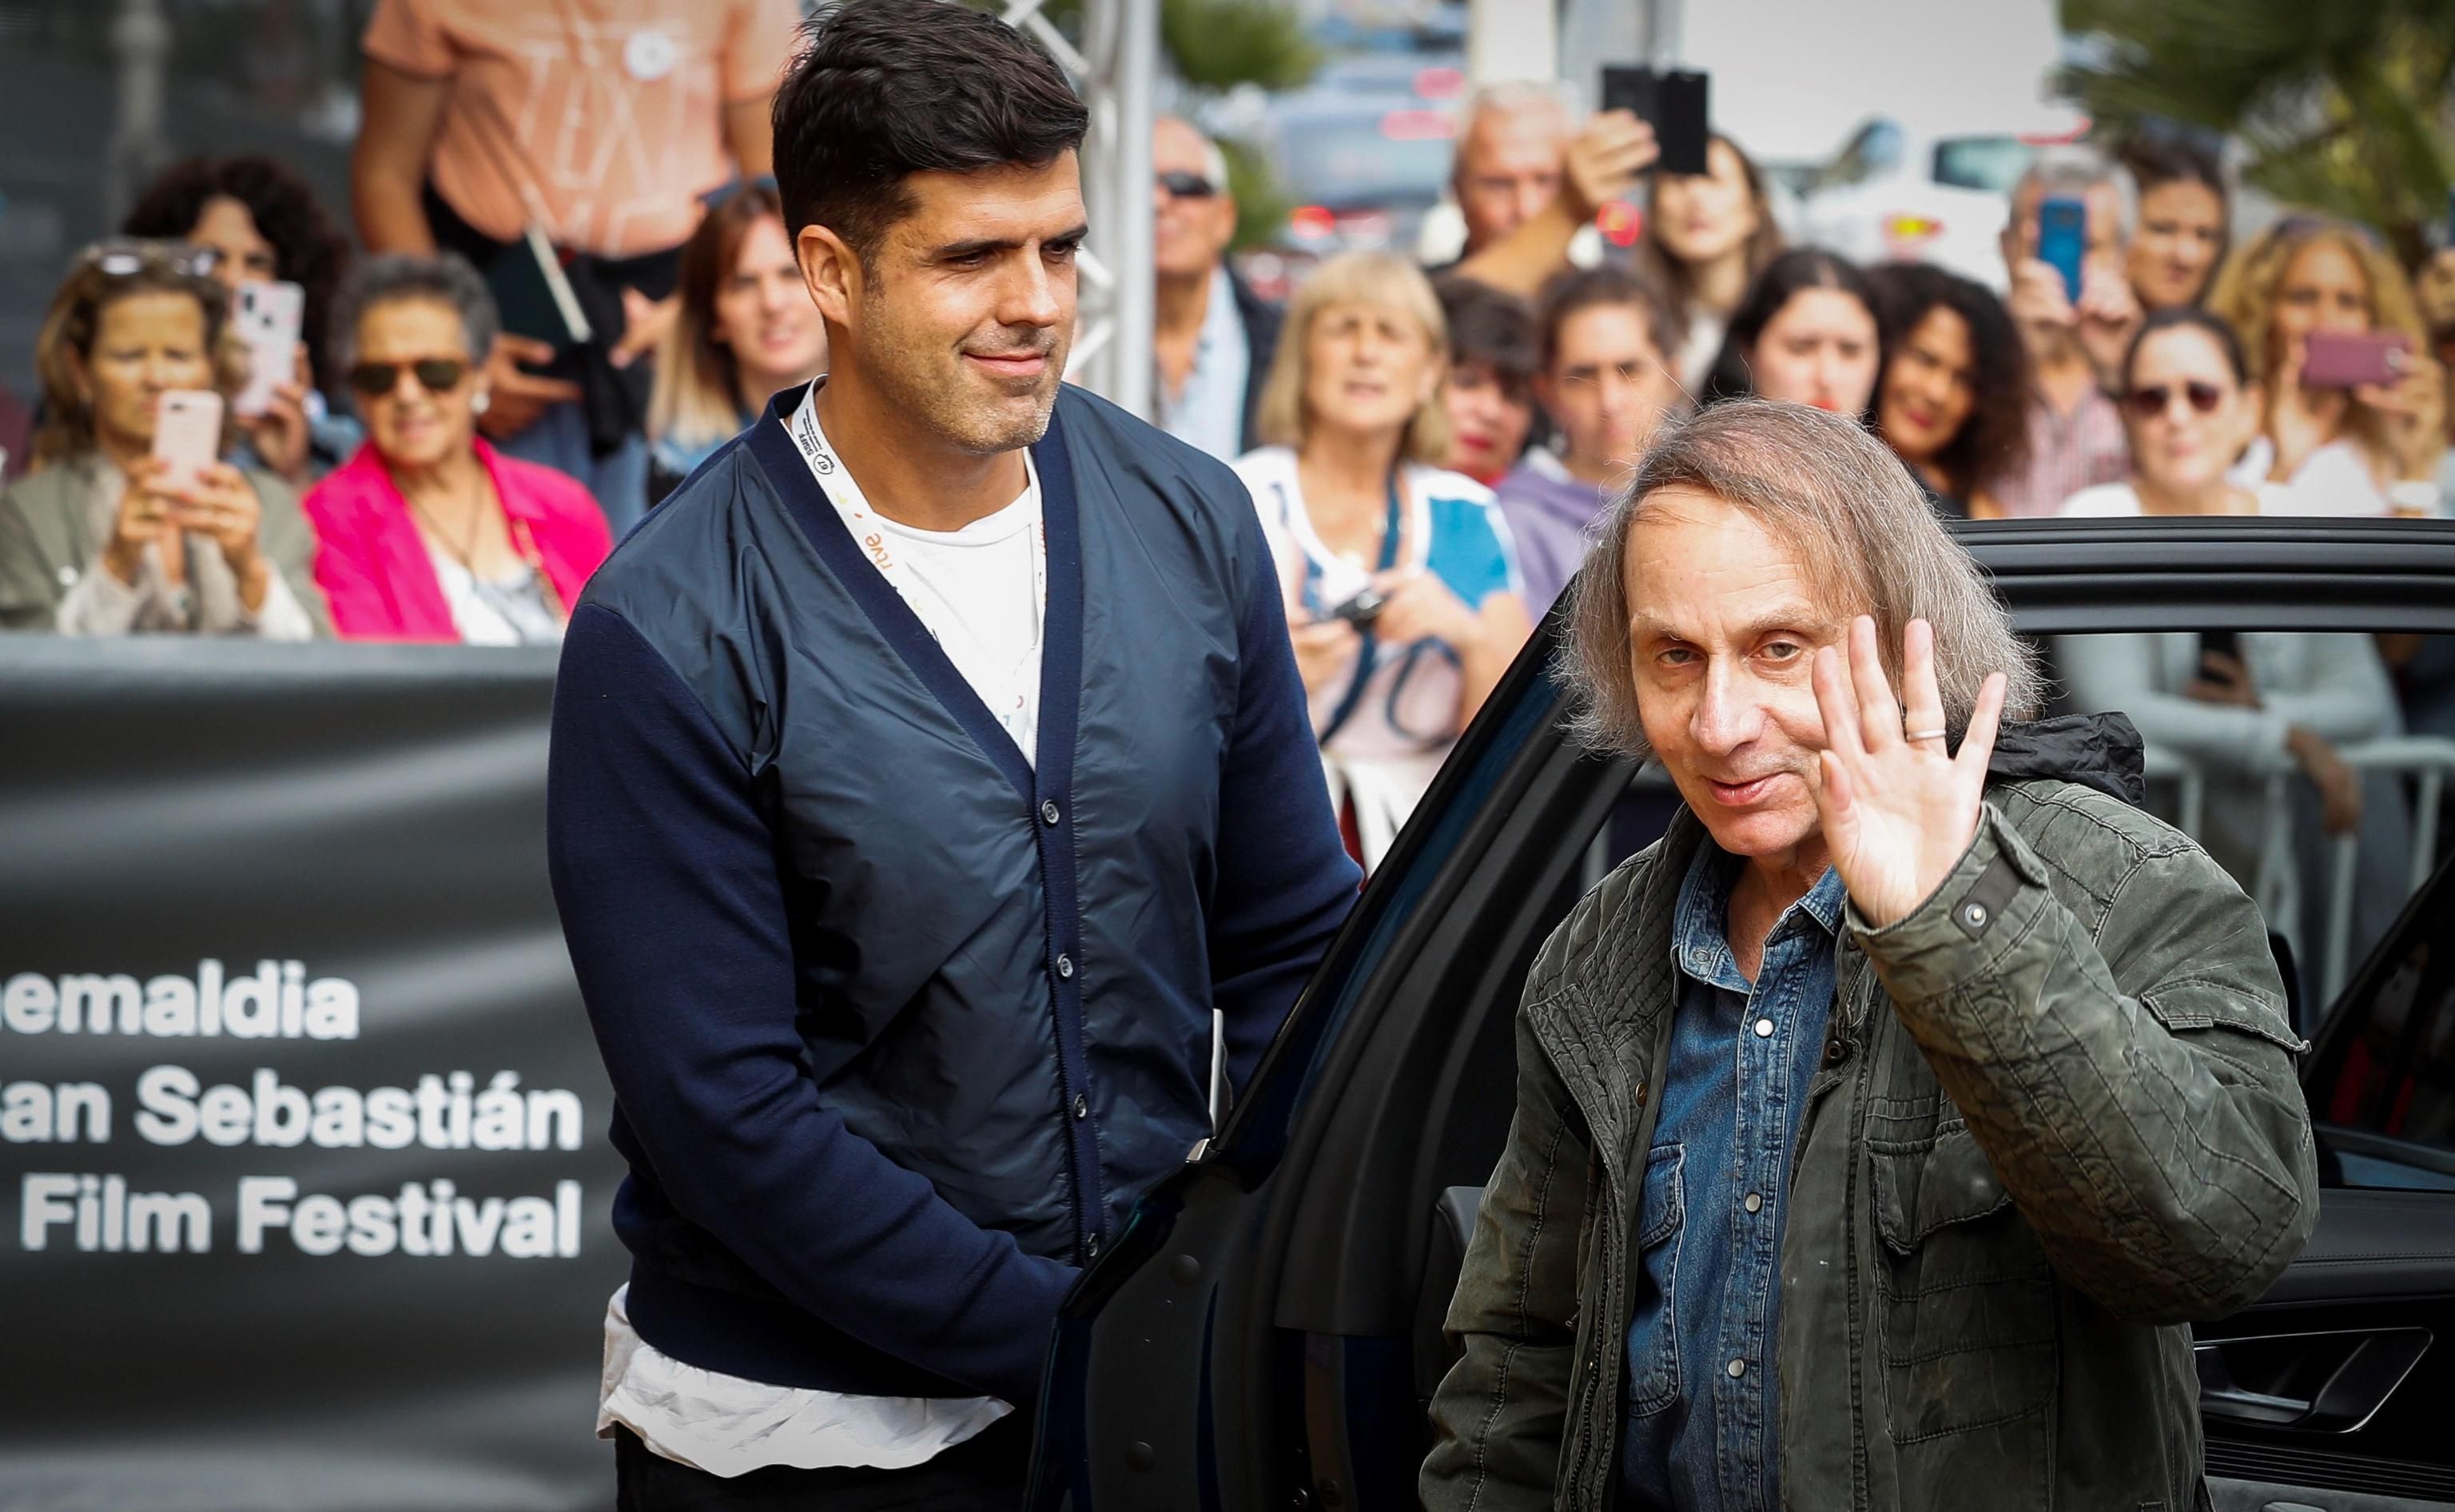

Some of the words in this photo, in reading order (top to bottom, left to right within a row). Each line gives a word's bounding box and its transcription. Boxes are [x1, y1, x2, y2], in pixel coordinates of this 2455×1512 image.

[818, 460, 829, 471] 67
[865, 532, 893, 570] rtve
[0, 958, 360, 1040] emaldia
[0, 1079, 112, 1144] an
[133, 1064, 584, 1151] Sebastián
[21, 1172, 213, 1253] Film
[237, 1176, 583, 1259] Festival
